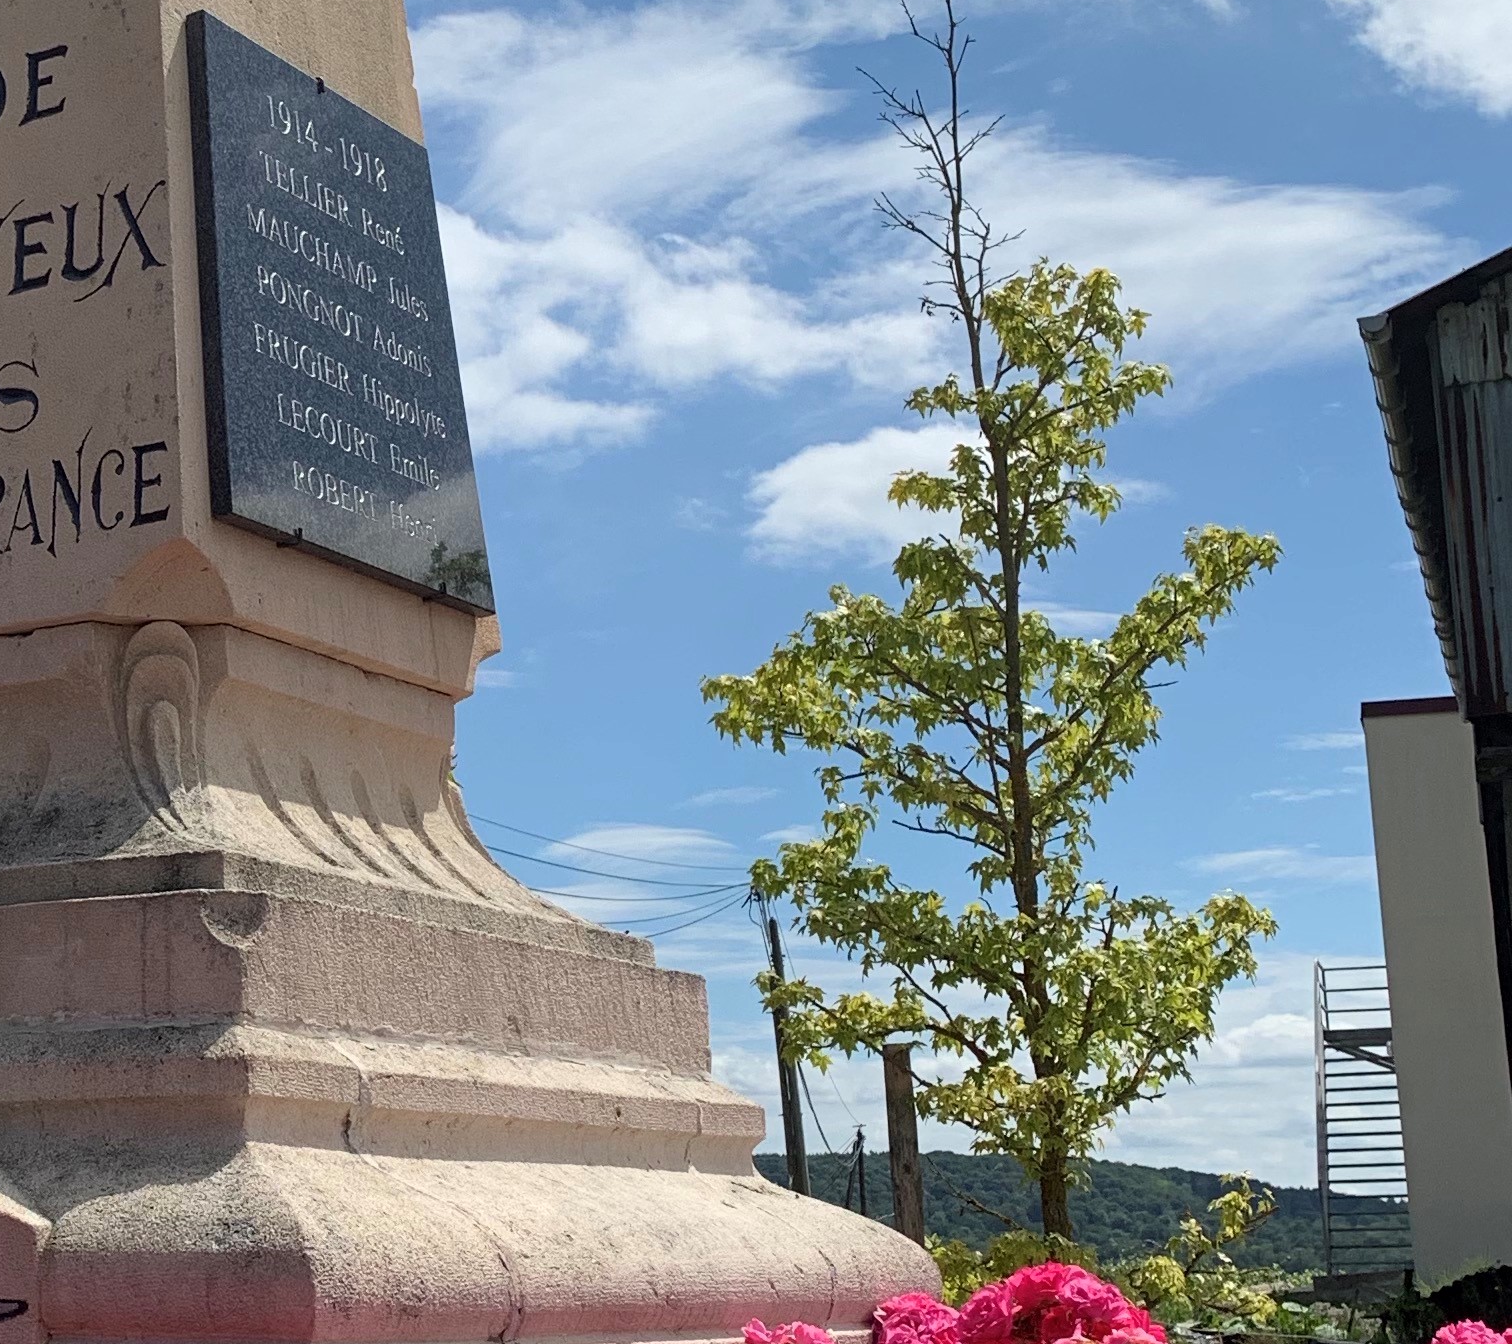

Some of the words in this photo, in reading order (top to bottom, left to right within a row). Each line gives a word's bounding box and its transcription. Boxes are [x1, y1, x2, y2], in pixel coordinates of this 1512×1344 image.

[259, 150, 353, 228] TELLIER
[361, 207, 405, 256] René
[246, 203, 377, 294] MAUCHAMP
[388, 276, 429, 322] Jules
[257, 265, 364, 344] PONGNOT
[373, 324, 432, 377] Adonis
[252, 320, 354, 396] FRUGIER
[362, 373, 446, 439] Hippolyte
[277, 393, 379, 465] LECOURT
[389, 442, 440, 491] Emile
[292, 460, 379, 523] ROBERT
